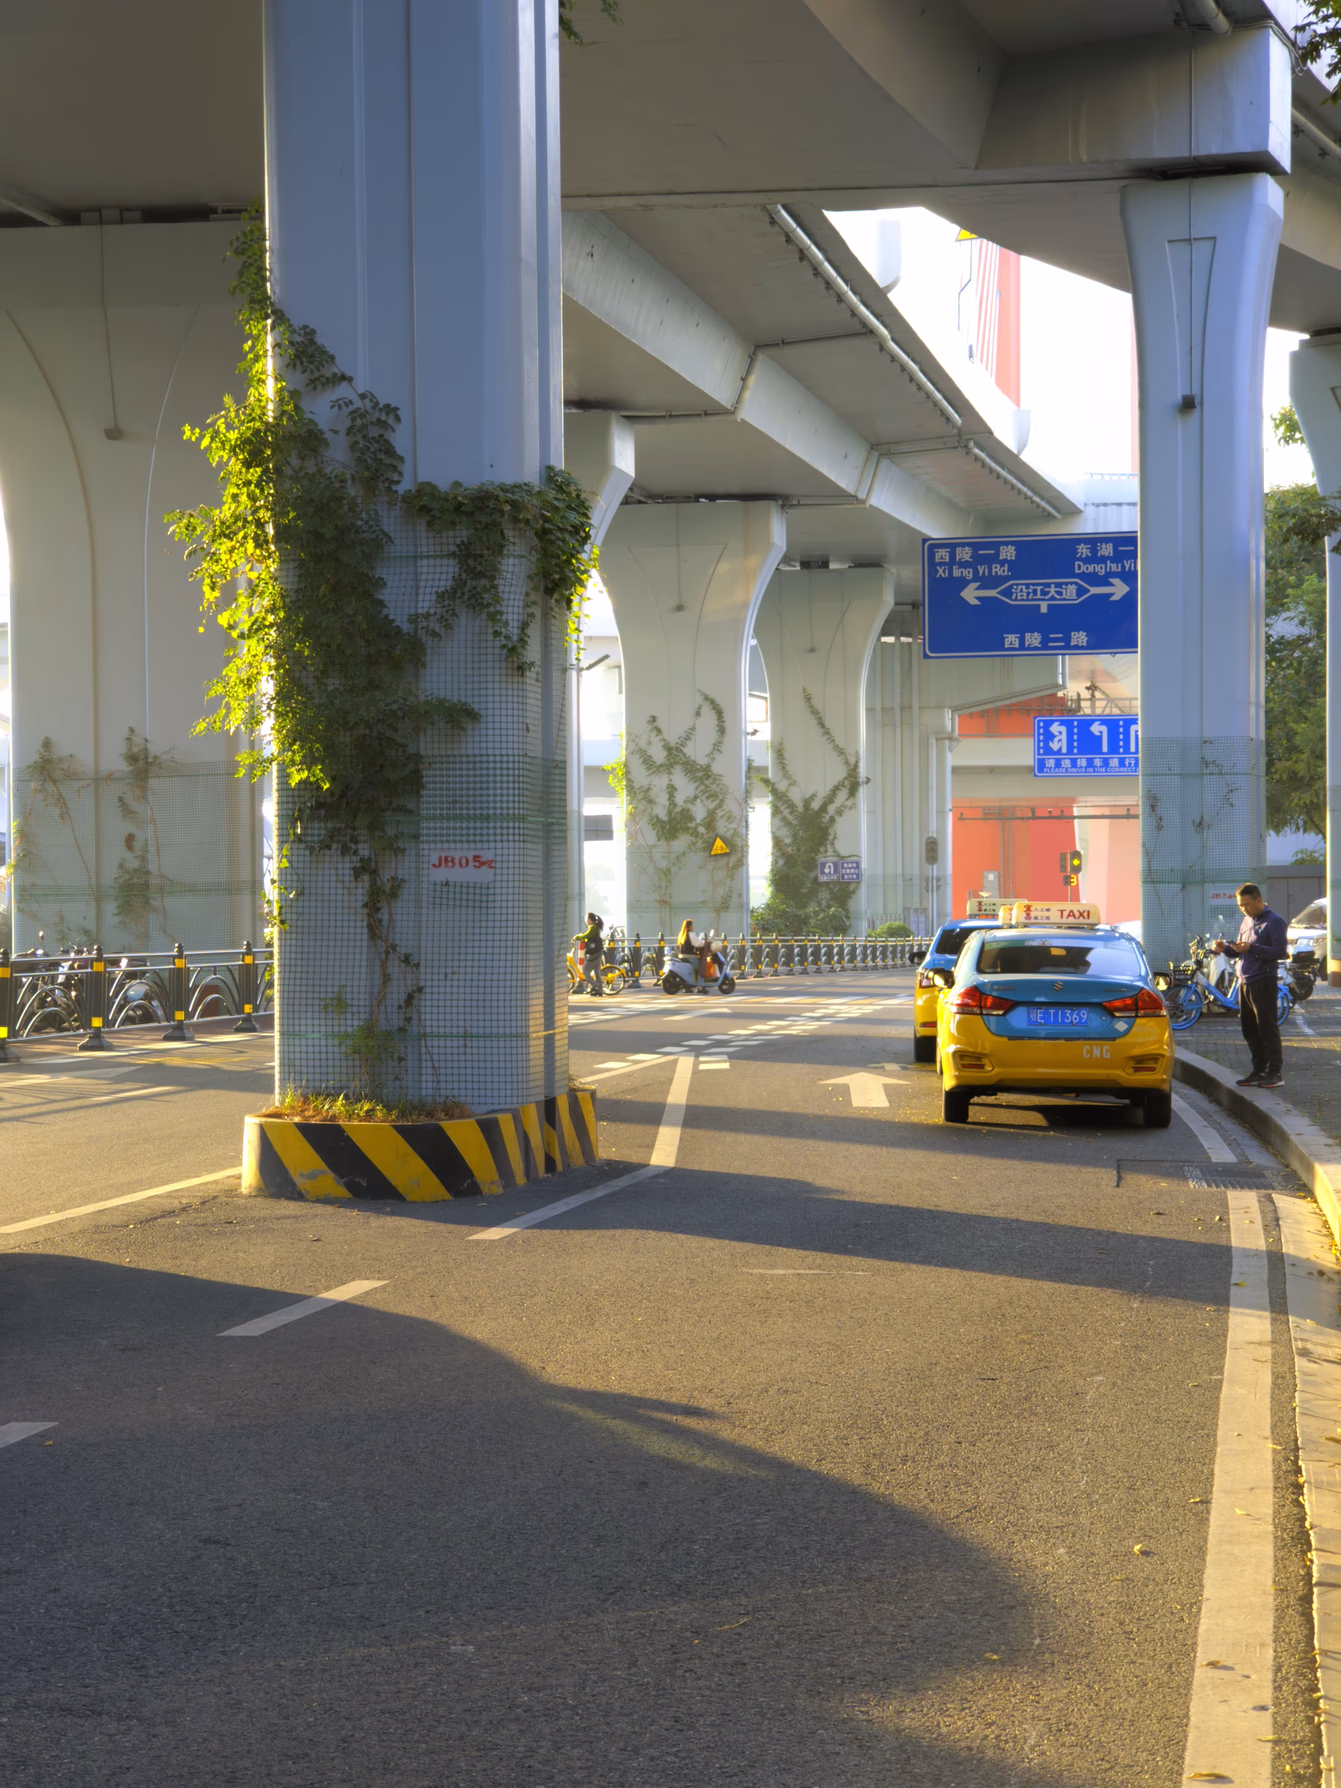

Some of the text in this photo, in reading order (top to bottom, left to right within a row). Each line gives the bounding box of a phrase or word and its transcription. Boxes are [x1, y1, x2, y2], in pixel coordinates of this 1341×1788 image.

[933, 545, 1016, 562] 西陵一路
[936, 566, 949, 578] Xi
[953, 565, 973, 580] ling
[992, 563, 1011, 576] Rd.
[1011, 583, 1078, 600] 沿江大道
[1003, 631, 1088, 648] 西陵二路
[1057, 909, 1090, 920] TAXI
[1083, 1045, 1111, 1058] CNG
